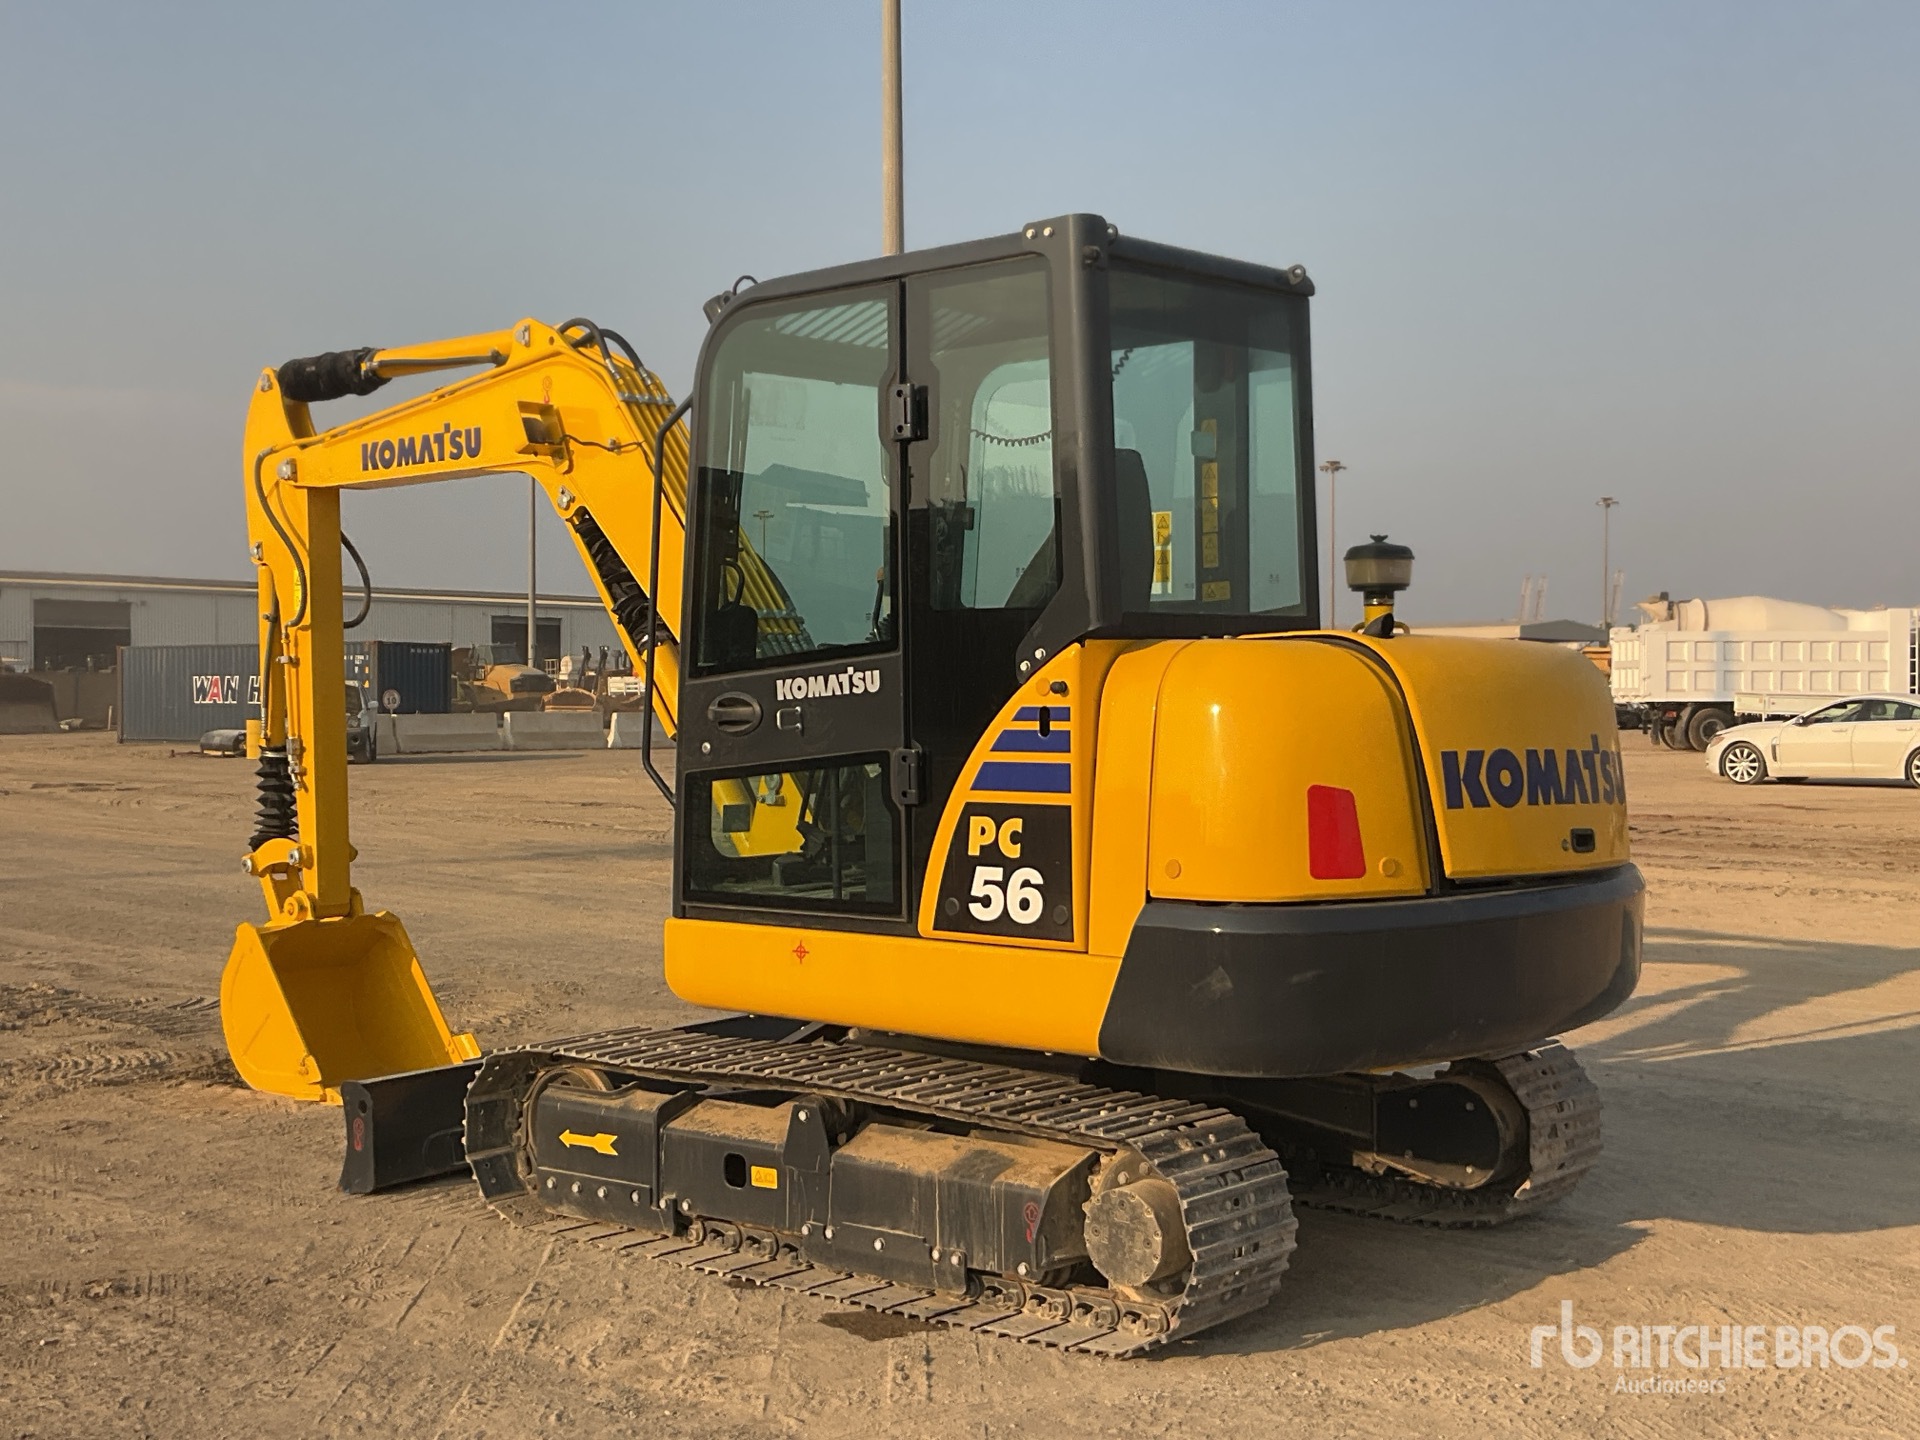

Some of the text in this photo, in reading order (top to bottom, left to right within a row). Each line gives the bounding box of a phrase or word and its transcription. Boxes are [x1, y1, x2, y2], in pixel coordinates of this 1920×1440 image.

[361, 422, 482, 471] KOMATSU
[192, 675, 240, 704] WAN
[776, 666, 880, 701] KOMATSU
[968, 815, 1023, 859] PC
[968, 865, 1044, 925] 56
